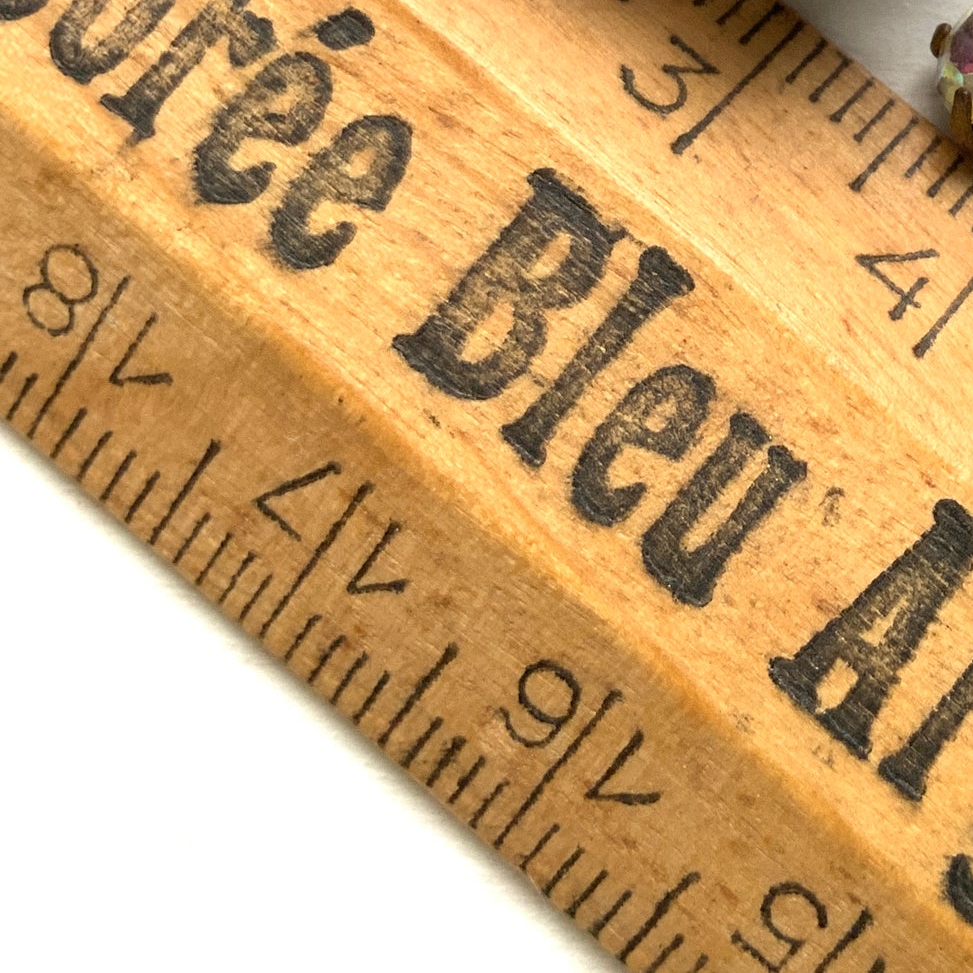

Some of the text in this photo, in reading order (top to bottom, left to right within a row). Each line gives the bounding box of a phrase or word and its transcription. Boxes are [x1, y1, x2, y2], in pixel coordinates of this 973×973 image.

[620, 34, 720, 115] 3
[855, 249, 939, 320] 4
[392, 167, 807, 609] Bleu
